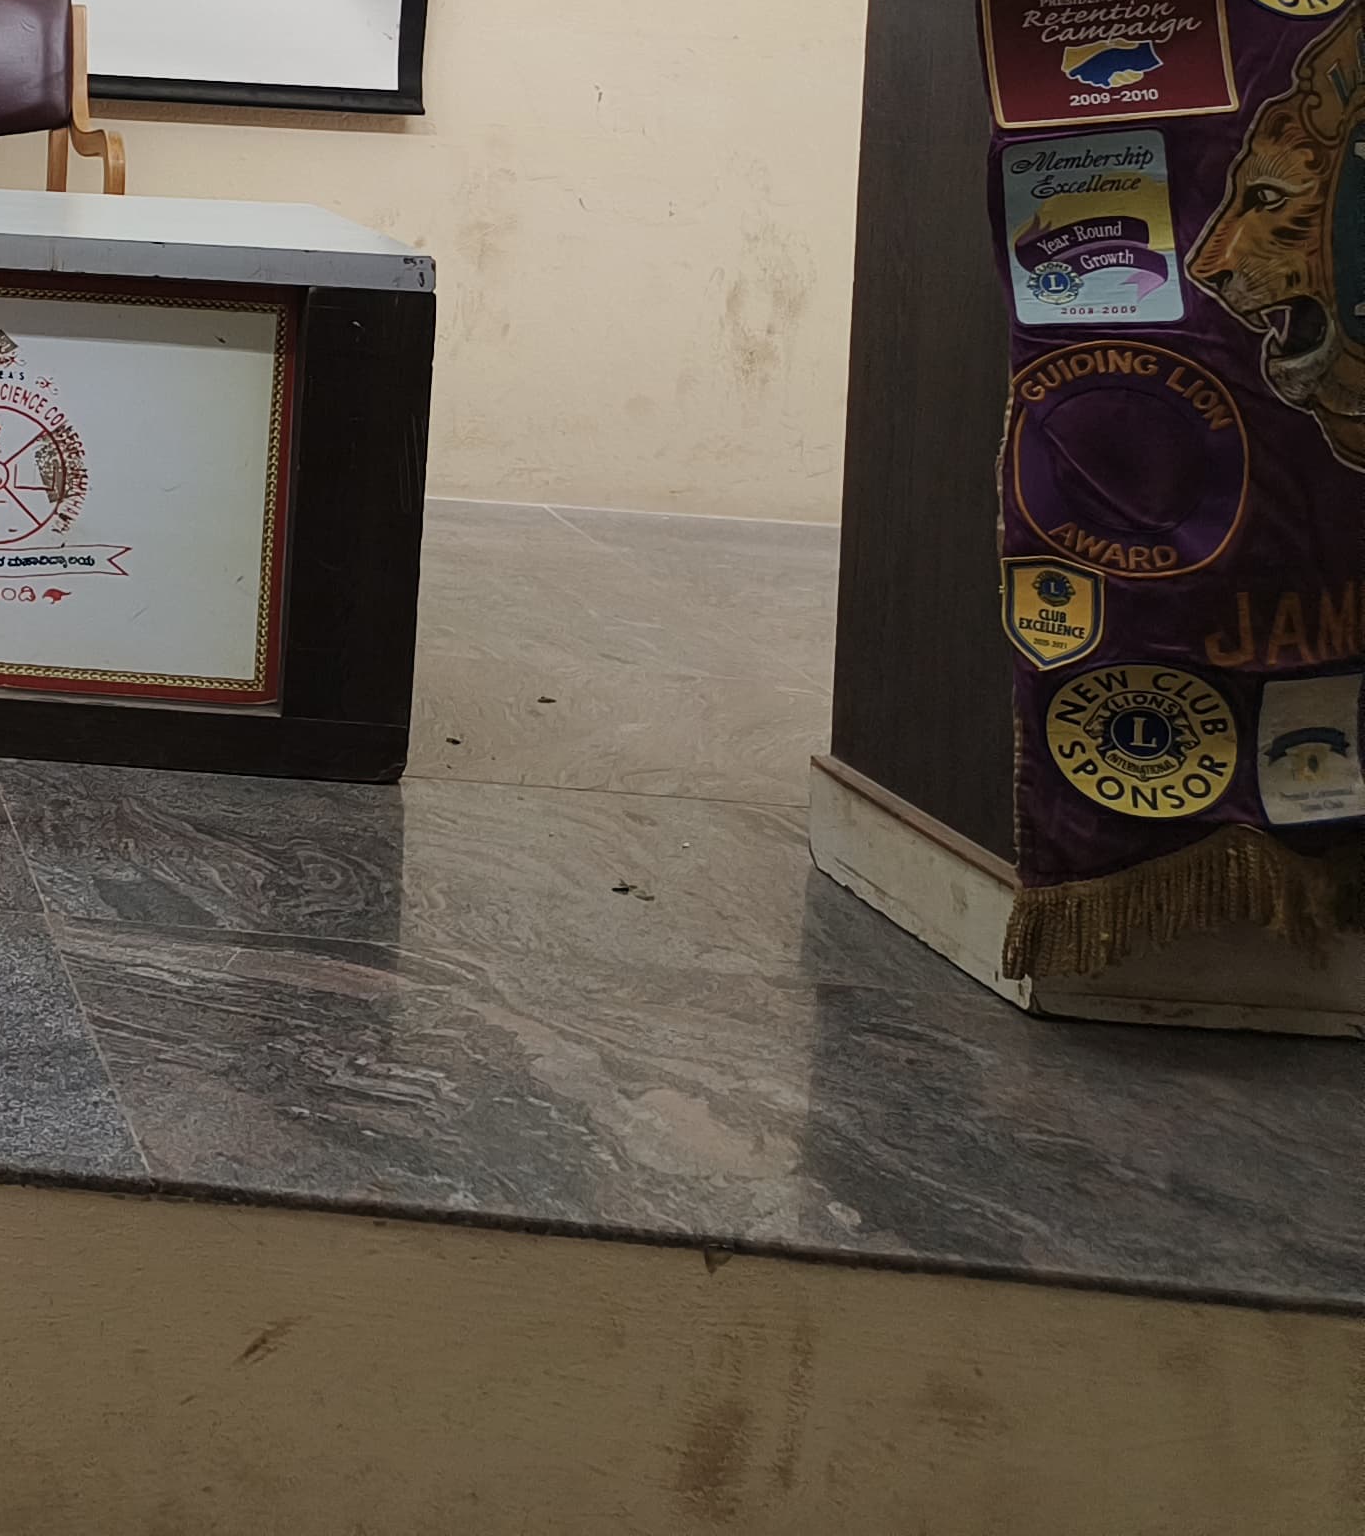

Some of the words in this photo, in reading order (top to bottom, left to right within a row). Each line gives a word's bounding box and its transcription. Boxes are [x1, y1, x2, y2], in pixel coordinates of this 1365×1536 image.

[1022, 0, 1176, 28] Retention
[1041, 14, 1203, 45] Campaign
[1069, 88, 1159, 107] 2009-2010
[1011, 145, 1155, 175] Membership
[1030, 174, 1143, 200] Excellence
[1037, 221, 1123, 256] Year-Round
[1080, 249, 1135, 271] Growth
[1049, 275, 1065, 291] L
[1021, 350, 1159, 401] GUIDING
[1166, 366, 1234, 431] LION
[1048, 521, 1179, 570] AWARD
[1019, 617, 1086, 640] EXCELLENCE
[1039, 608, 1067, 623] CLUB
[1204, 578, 1365, 668] JAM
[1055, 670, 1129, 726] NEW
[1152, 672, 1228, 736] CLUB
[1111, 693, 1180, 715] LIONS
[1129, 716, 1158, 749] L
[1058, 740, 1228, 811] SPONSOR
